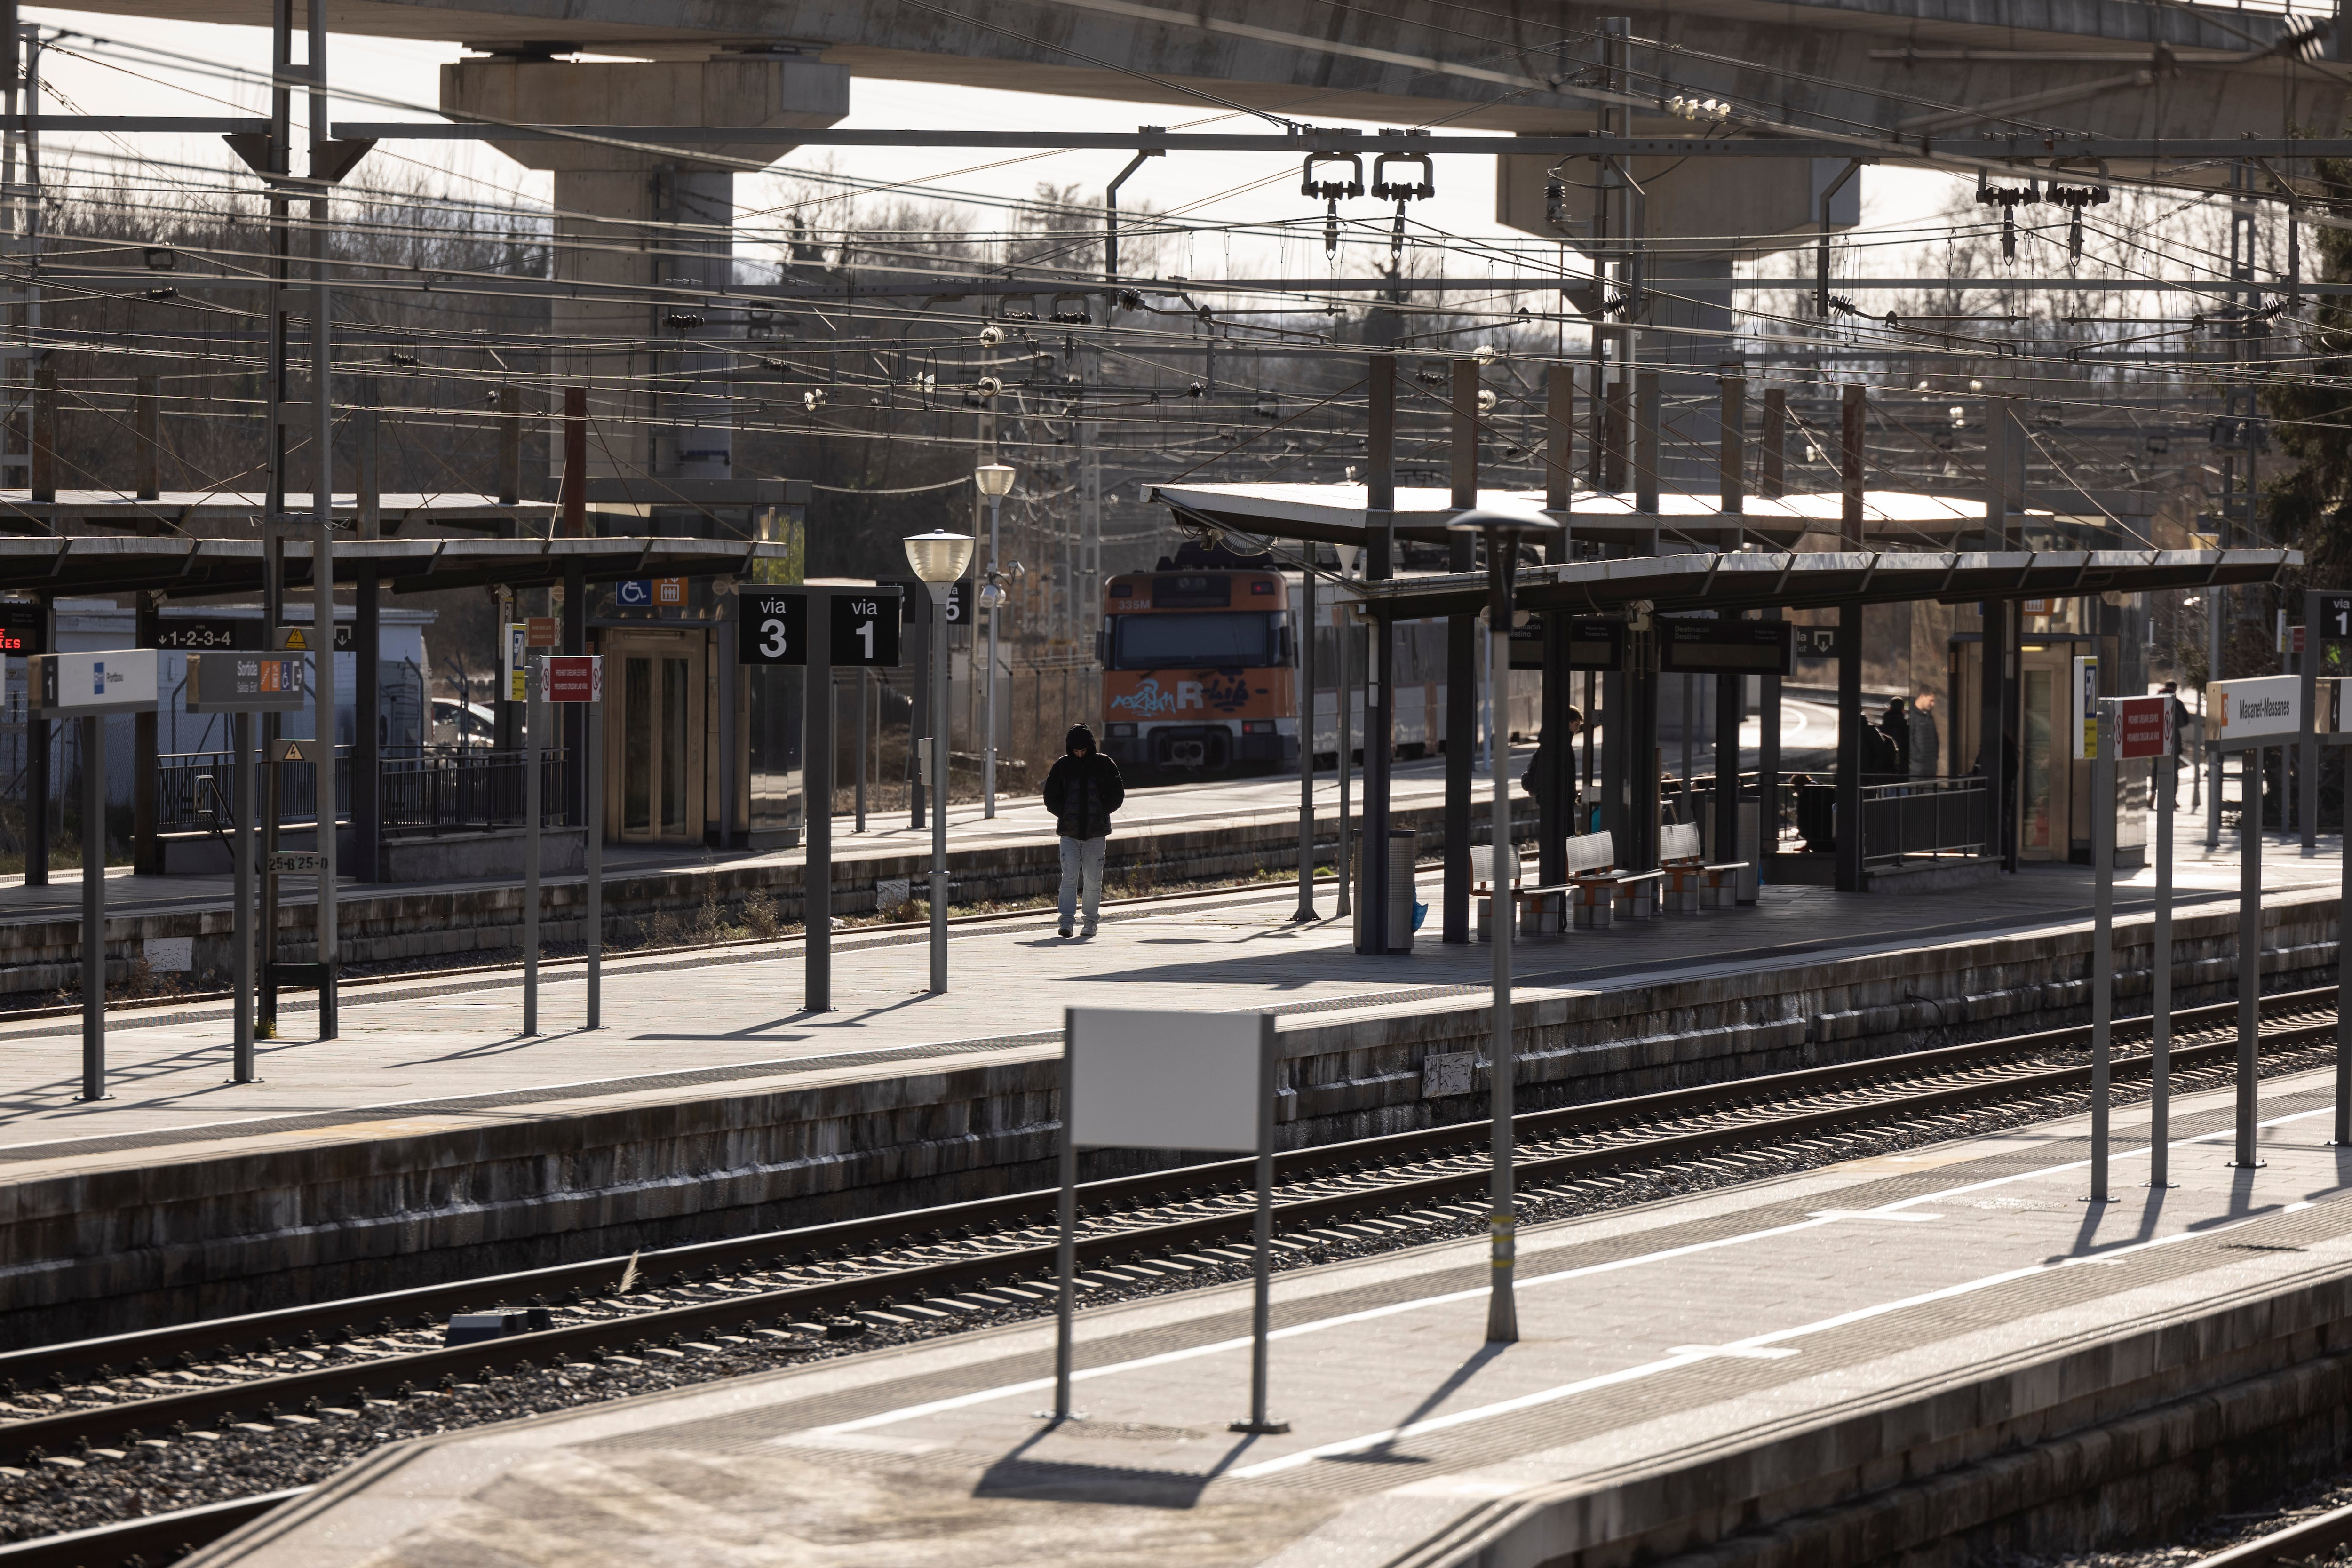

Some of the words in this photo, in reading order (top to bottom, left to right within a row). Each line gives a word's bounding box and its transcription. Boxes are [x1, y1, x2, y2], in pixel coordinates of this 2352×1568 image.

[760, 597, 787, 613] via
[851, 598, 878, 615] via
[946, 597, 960, 621] 5
[1118, 600, 1150, 610] 335M
[2333, 598, 2350, 609] via
[2336, 612, 2347, 635] 1
[170, 631, 231, 645] 1-2-3-4
[759, 618, 787, 658] 3
[856, 621, 874, 659] 1
[237, 661, 258, 676] Sortida
[48, 676, 53, 699] 1
[1177, 681, 1204, 709] R
[2239, 697, 2290, 724] Maçanet-Massanes
[2333, 700, 2337, 724] 4
